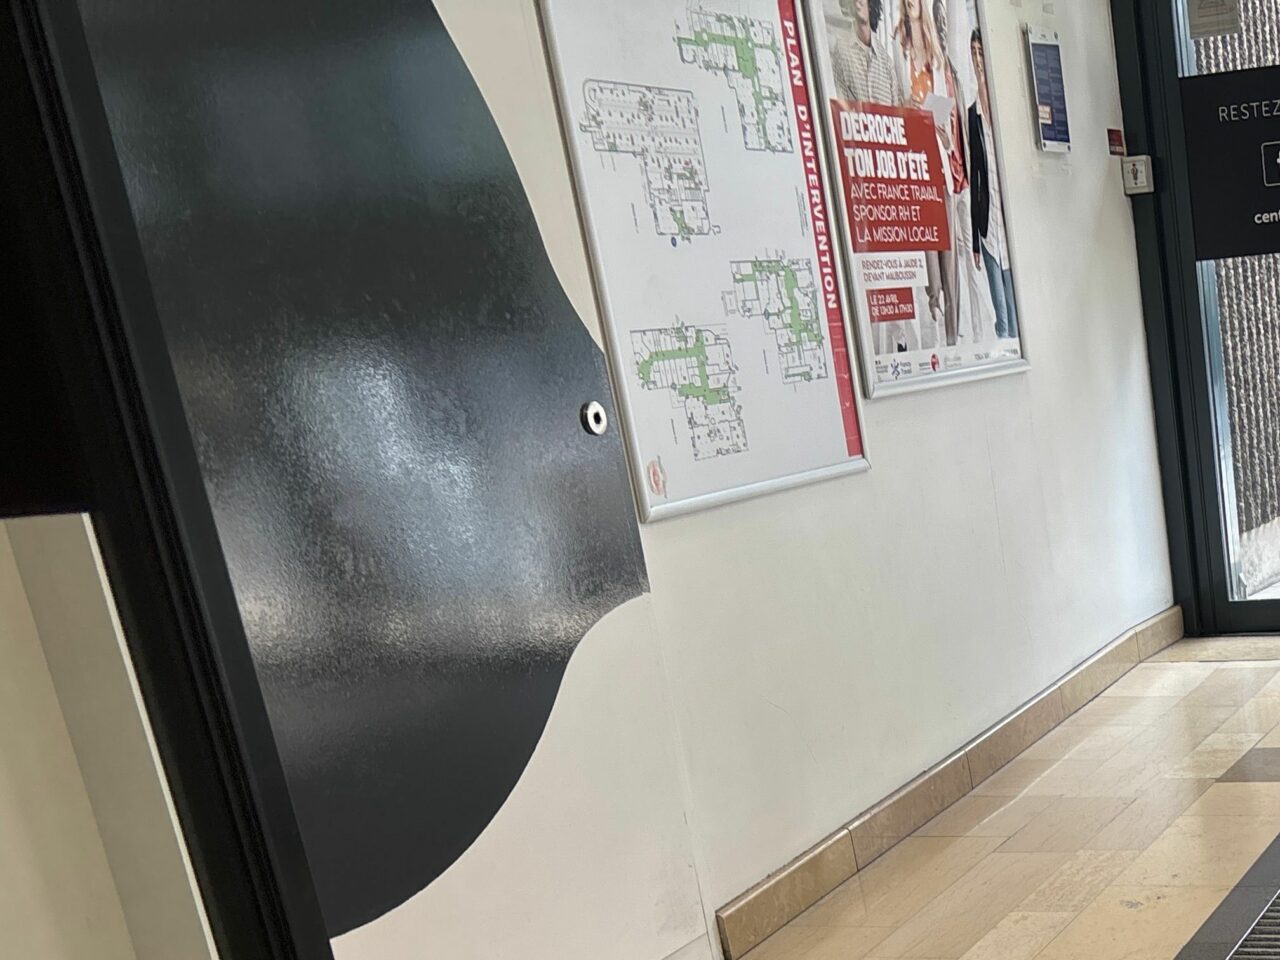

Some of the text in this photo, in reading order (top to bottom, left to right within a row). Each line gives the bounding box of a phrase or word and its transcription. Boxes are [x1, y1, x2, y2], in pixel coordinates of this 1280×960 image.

[784, 20, 803, 87] PLAN
[797, 105, 837, 309] D'INTERVENTION
[844, 147, 930, 181] TON JOB D'ÉTÉ
[851, 183, 876, 199] AVEC
[877, 184, 909, 201] FRANCE
[853, 204, 921, 221] SPONSOR RH ET
[856, 225, 939, 243] LA MISSION LOCALE
